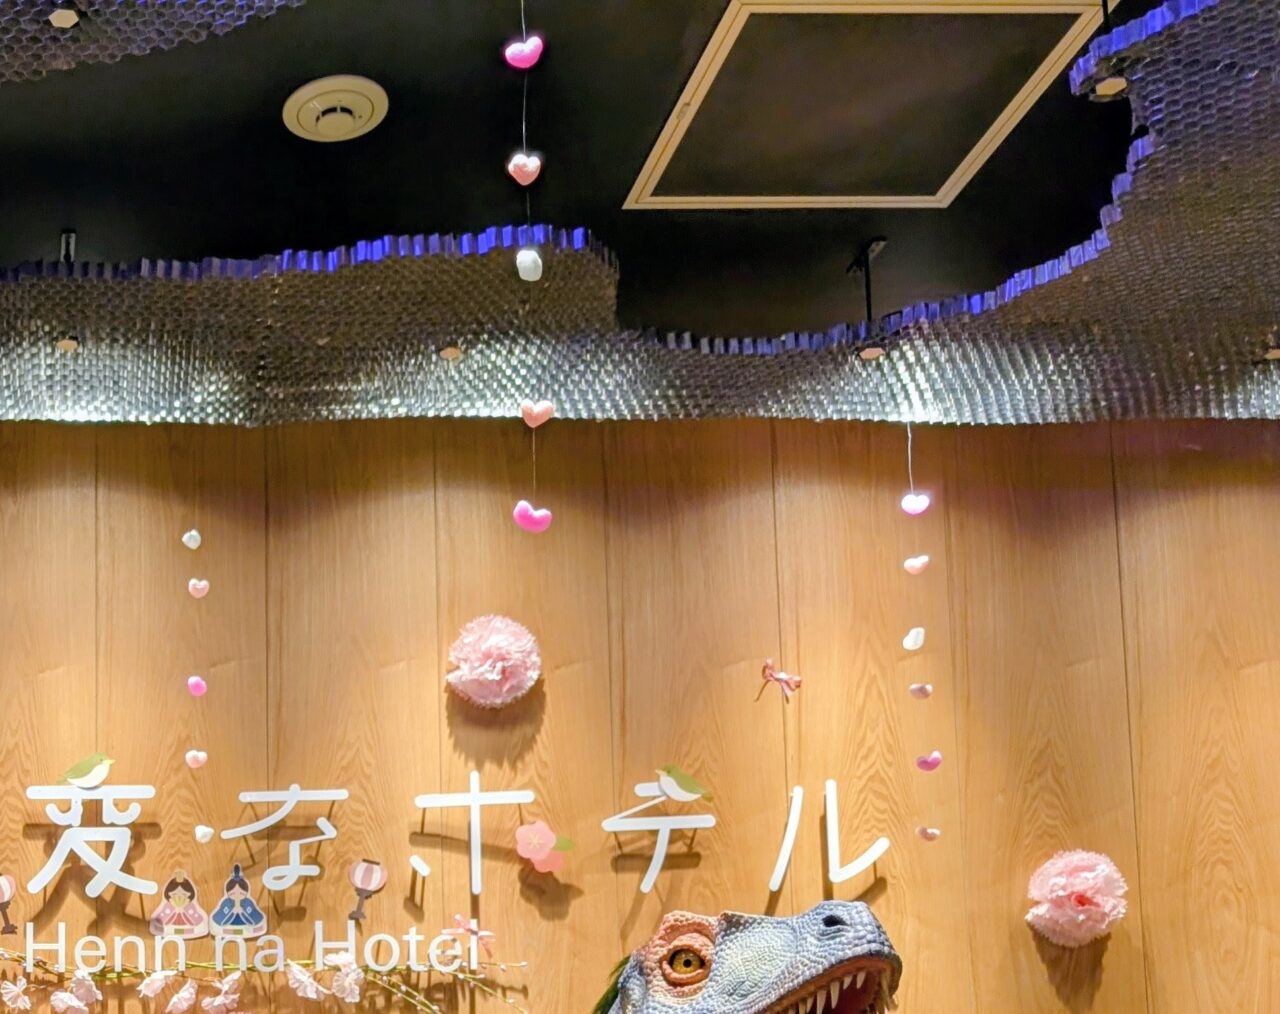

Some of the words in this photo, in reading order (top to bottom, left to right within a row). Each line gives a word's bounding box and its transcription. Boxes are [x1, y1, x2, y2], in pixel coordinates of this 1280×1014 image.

[25, 770, 891, 898] 変なホテル
[24, 921, 188, 974] Henn
[214, 934, 286, 974] na
[314, 919, 480, 974] Hotel
